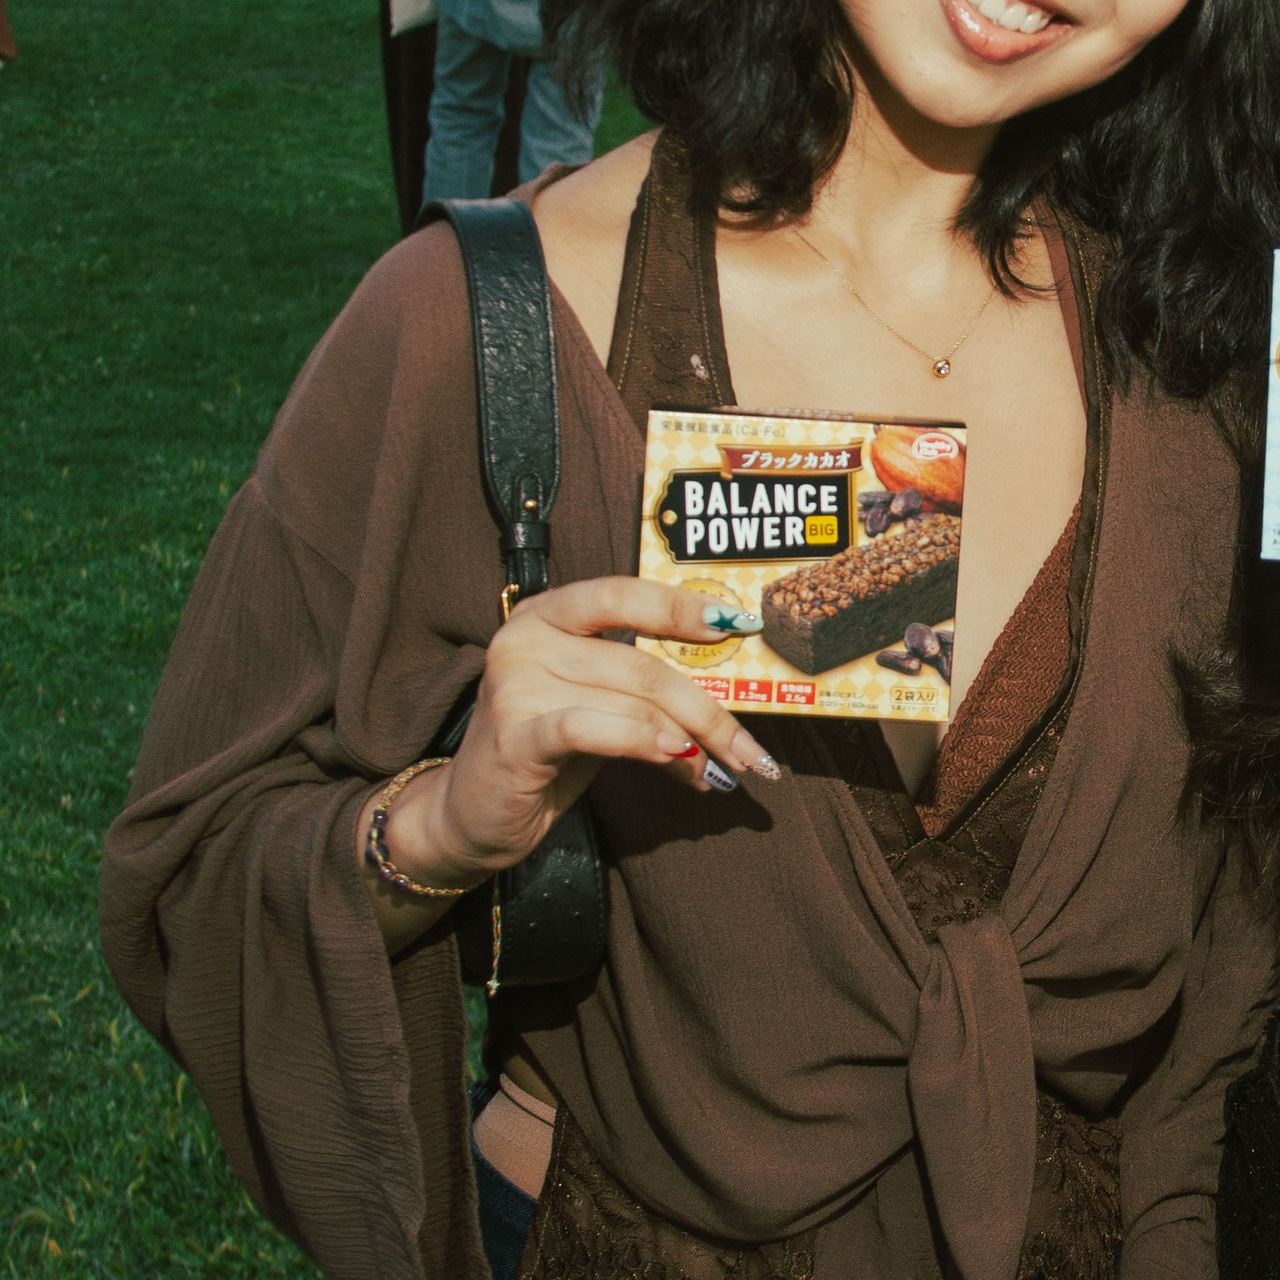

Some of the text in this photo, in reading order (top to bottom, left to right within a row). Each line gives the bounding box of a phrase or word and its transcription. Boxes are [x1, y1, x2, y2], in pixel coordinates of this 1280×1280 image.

[741, 449, 851, 470] ブラックカカオ
[684, 480, 839, 516] BALANCE
[685, 515, 836, 556] POWER BIG
